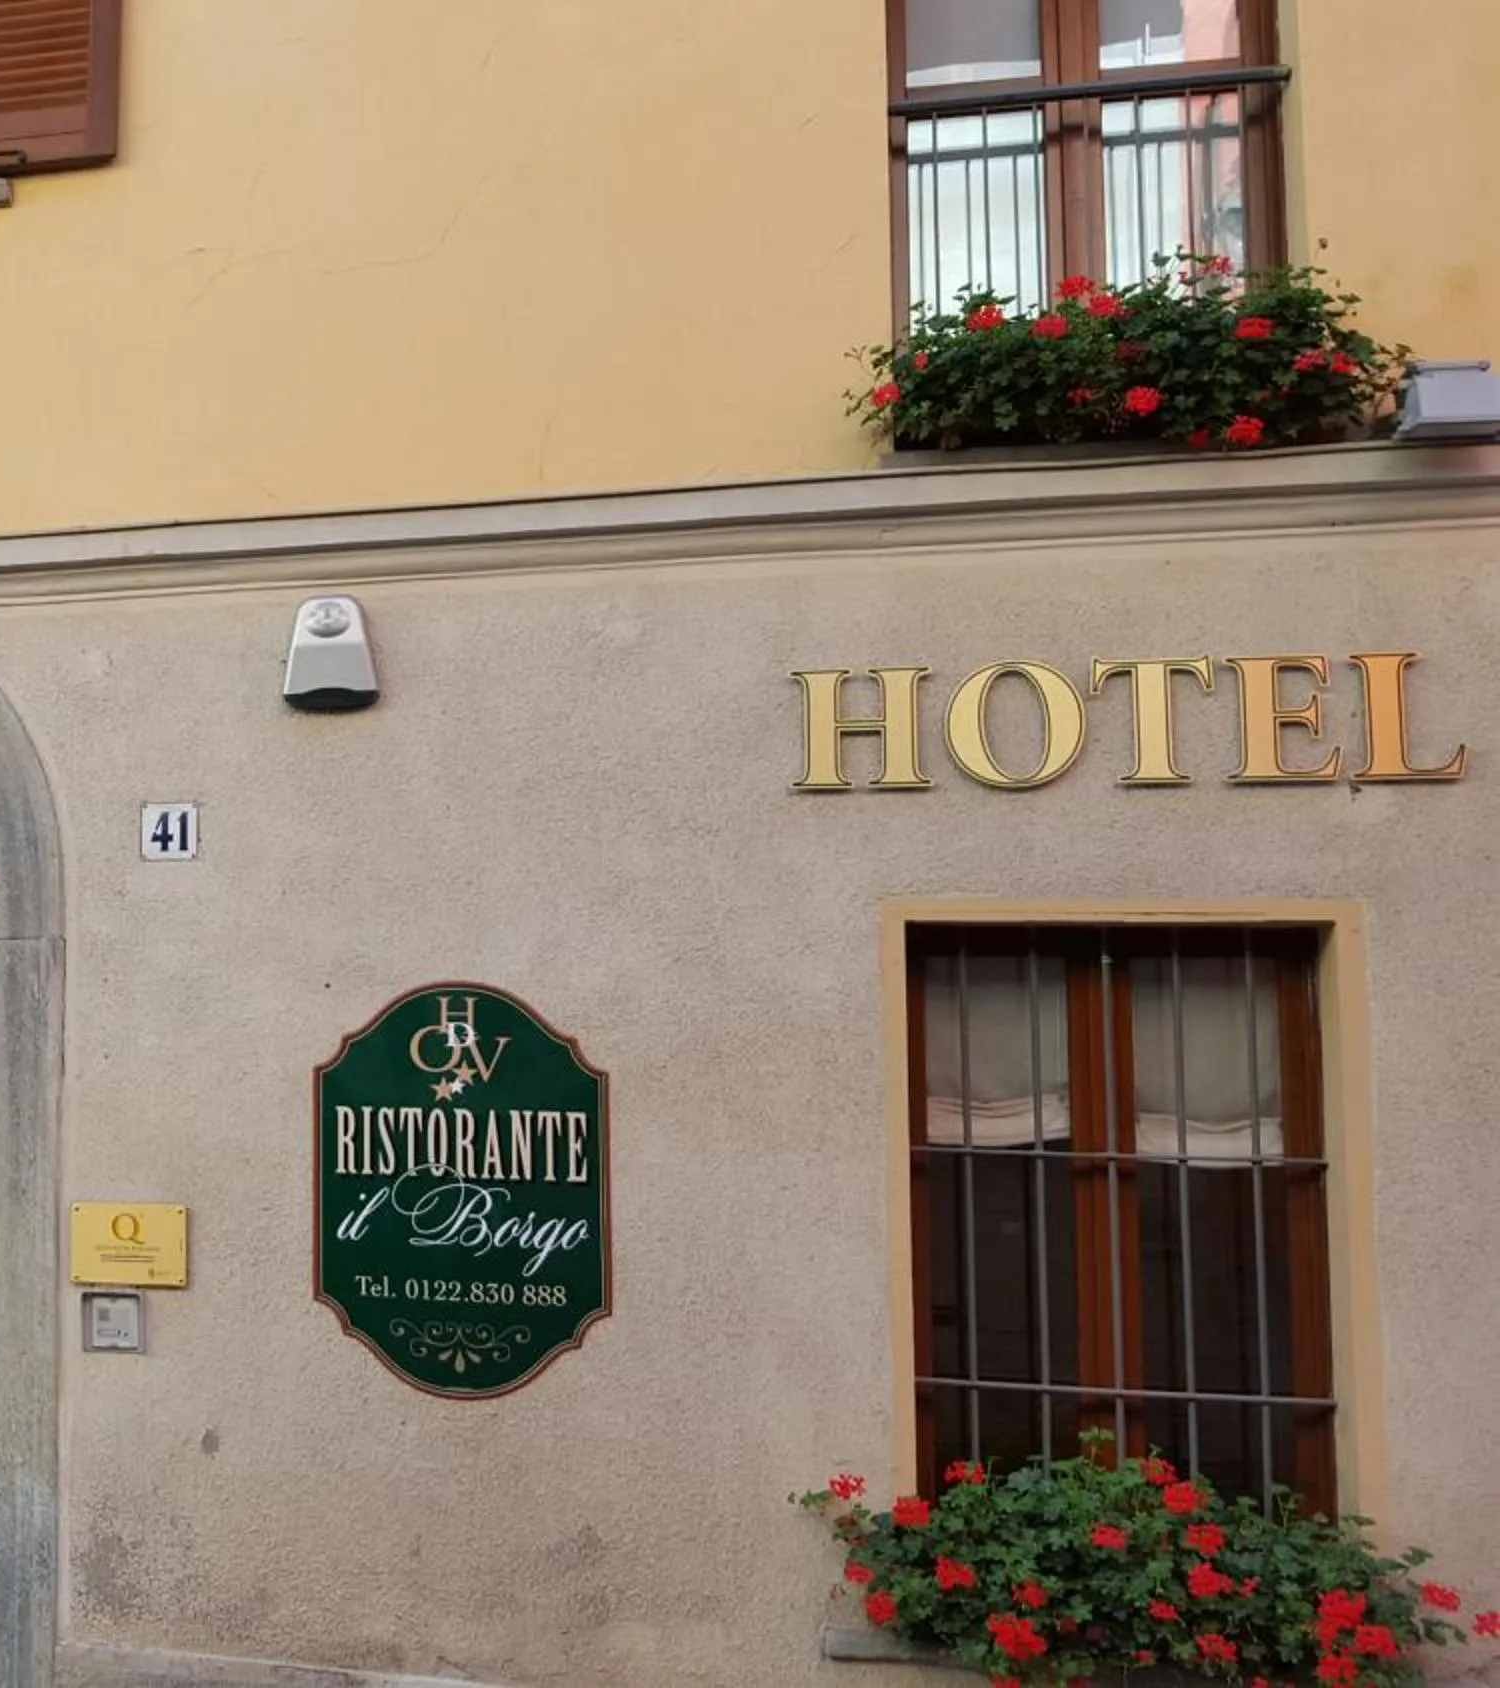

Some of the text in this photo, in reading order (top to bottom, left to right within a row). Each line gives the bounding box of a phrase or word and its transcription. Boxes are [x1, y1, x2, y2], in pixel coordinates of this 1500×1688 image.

[790, 652, 1466, 790] HOTEL
[150, 811, 189, 852] 41
[335, 1105, 588, 1183] RISTORANTE
[111, 1213, 146, 1245] Q
[336, 1164, 590, 1277] il Borgo
[355, 1275, 567, 1307] Tel. 0122.830 888
